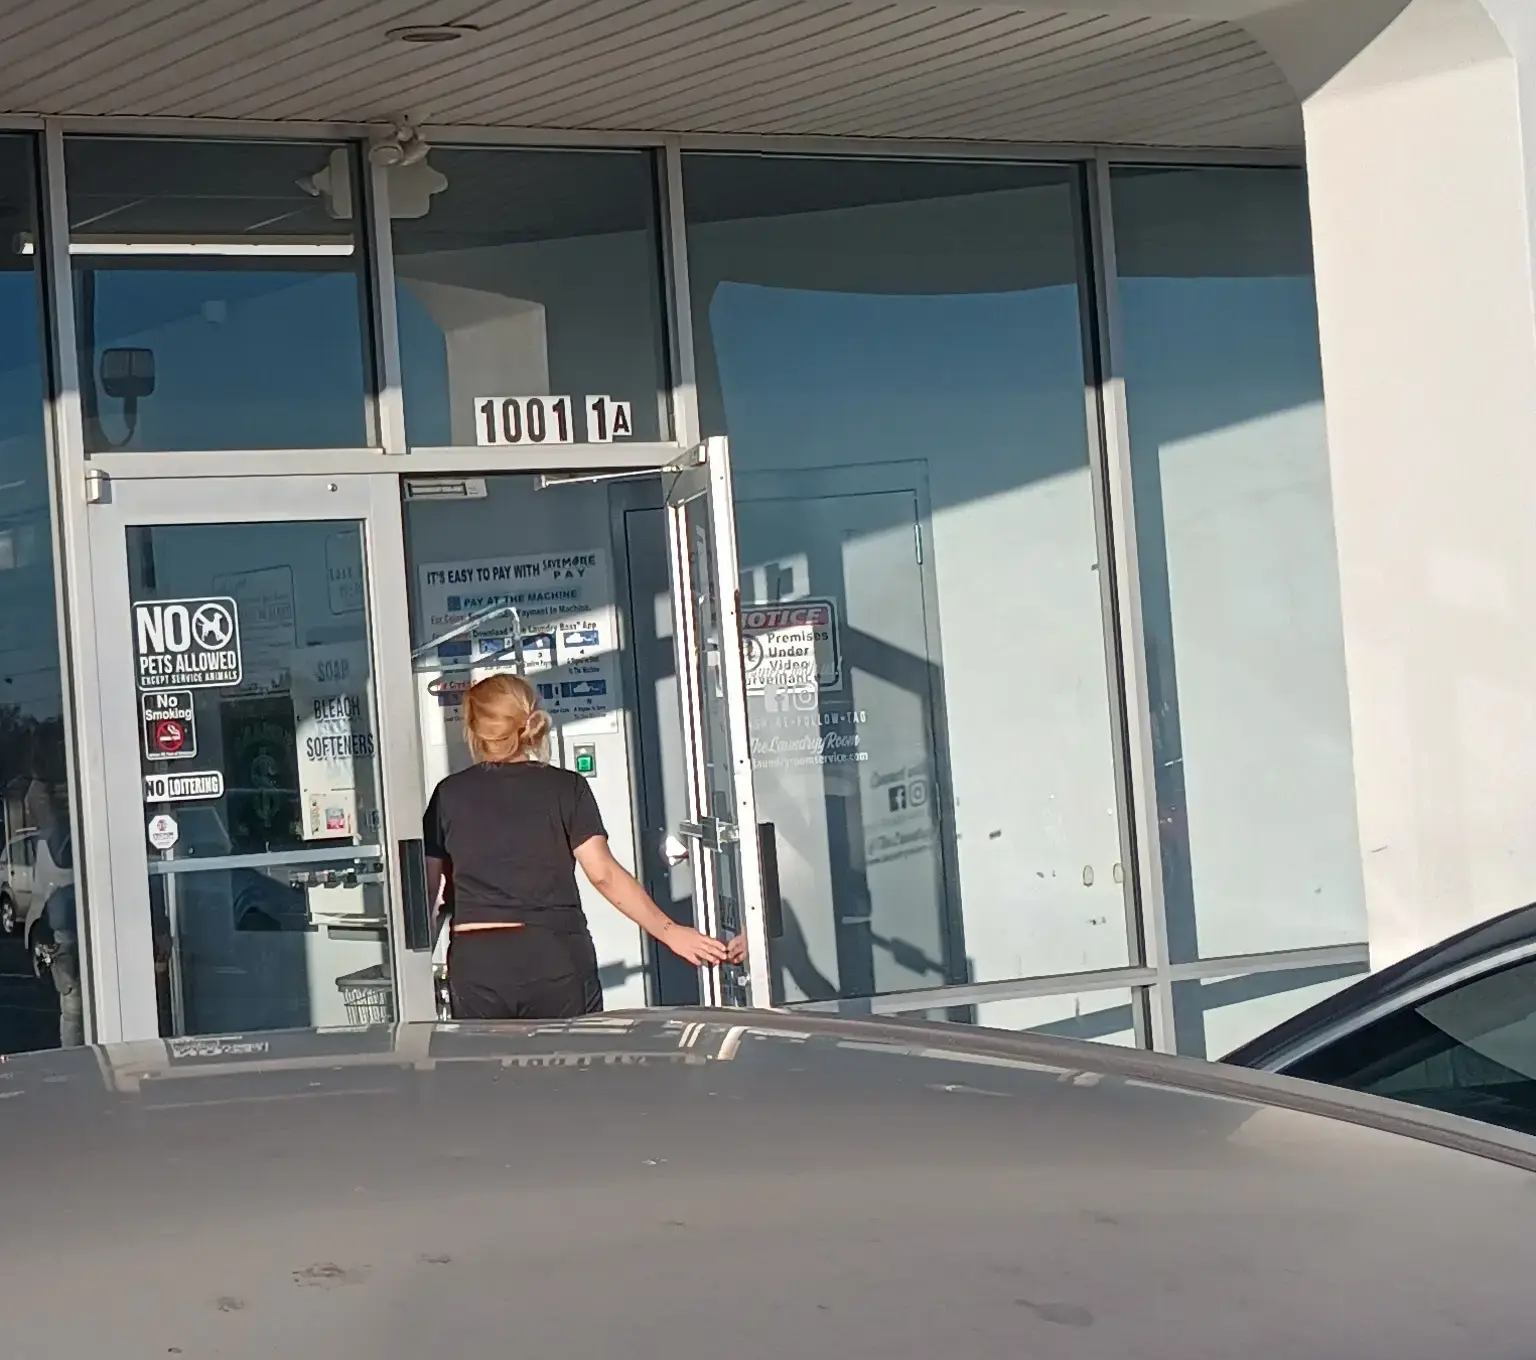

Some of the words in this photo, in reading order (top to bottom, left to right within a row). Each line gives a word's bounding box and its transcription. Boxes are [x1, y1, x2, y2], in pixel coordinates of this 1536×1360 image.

[480, 397, 568, 444] 1001
[426, 571, 446, 586] IT'S
[448, 568, 474, 584] EASY
[476, 567, 490, 582] TO
[492, 565, 512, 580] PAY
[513, 563, 541, 579] WITH
[553, 568, 586, 580] PAY
[463, 596, 484, 609] PAY
[527, 589, 578, 603] MACHINE
[135, 605, 192, 654] NO
[767, 630, 829, 644] Premises
[139, 654, 173, 675] PETS
[175, 650, 237, 673] ALLOWED
[768, 646, 810, 658] Under
[316, 659, 349, 682] SOAP
[769, 659, 810, 672] Video
[156, 693, 178, 708] No
[314, 695, 361, 720] BLEACH
[145, 708, 193, 721] Smoking
[306, 733, 375, 758] SOFTENERS
[146, 779, 165, 797] NO
[168, 776, 220, 797] LOITERING
